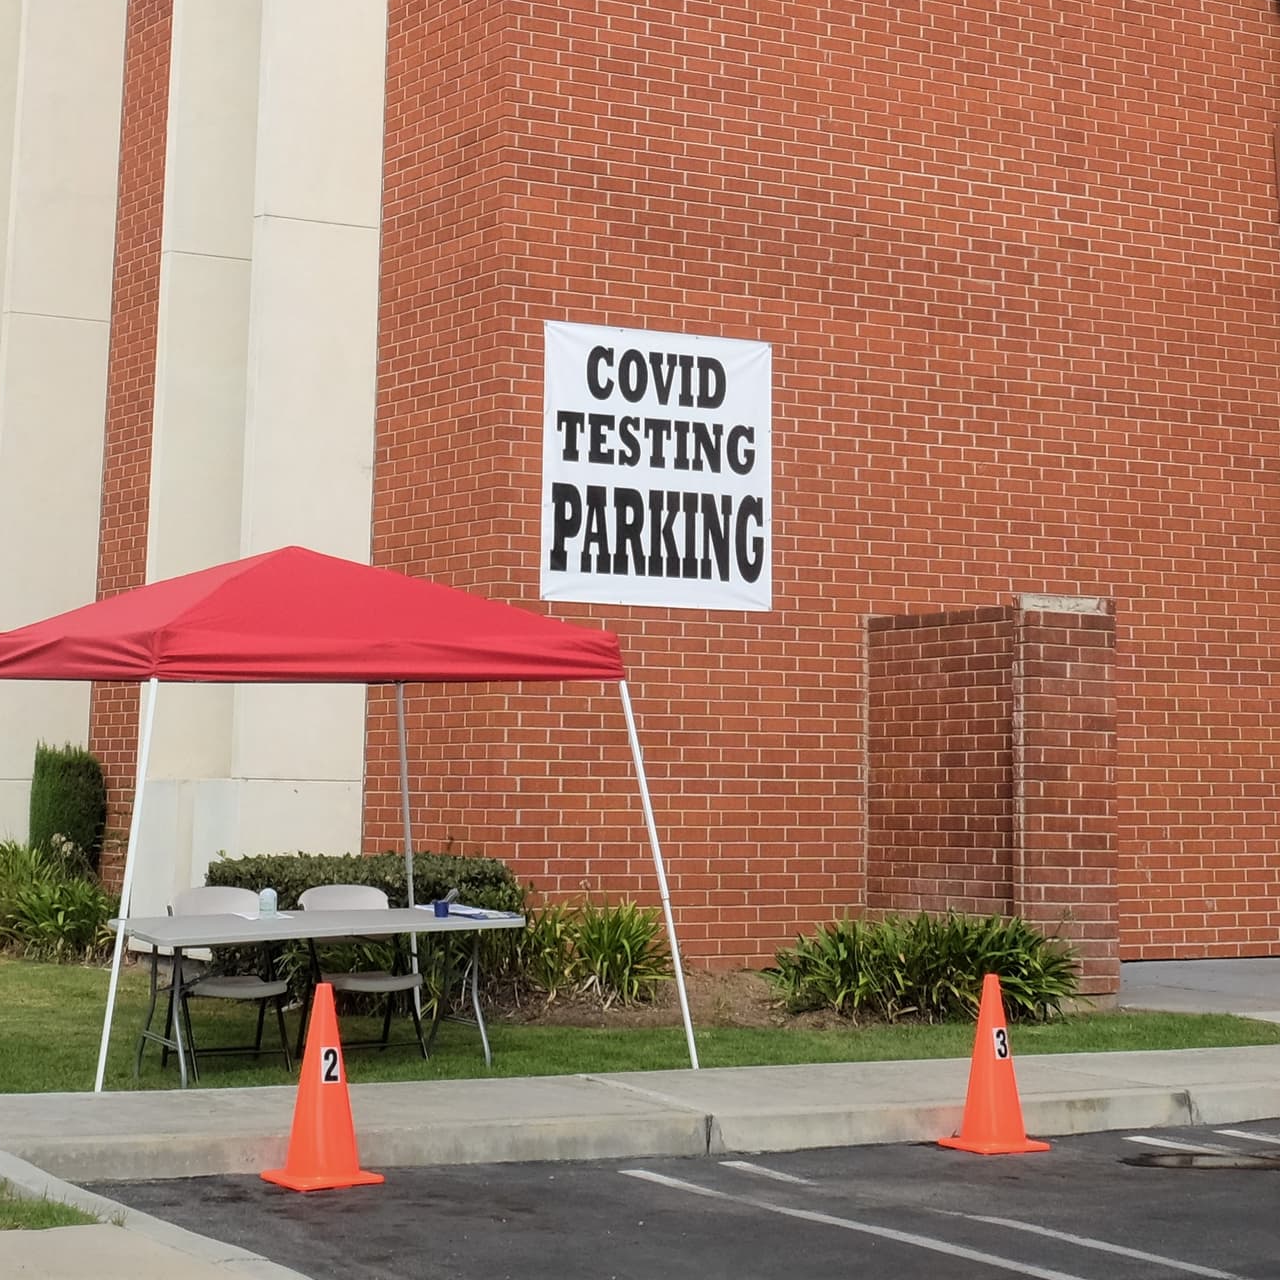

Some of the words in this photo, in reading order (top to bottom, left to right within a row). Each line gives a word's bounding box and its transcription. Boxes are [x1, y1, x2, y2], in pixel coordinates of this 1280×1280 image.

[586, 345, 726, 409] COVID
[557, 410, 756, 475] TESTING
[549, 482, 765, 583] PARKING
[323, 1048, 339, 1082] 2
[996, 1029, 1008, 1058] 3
